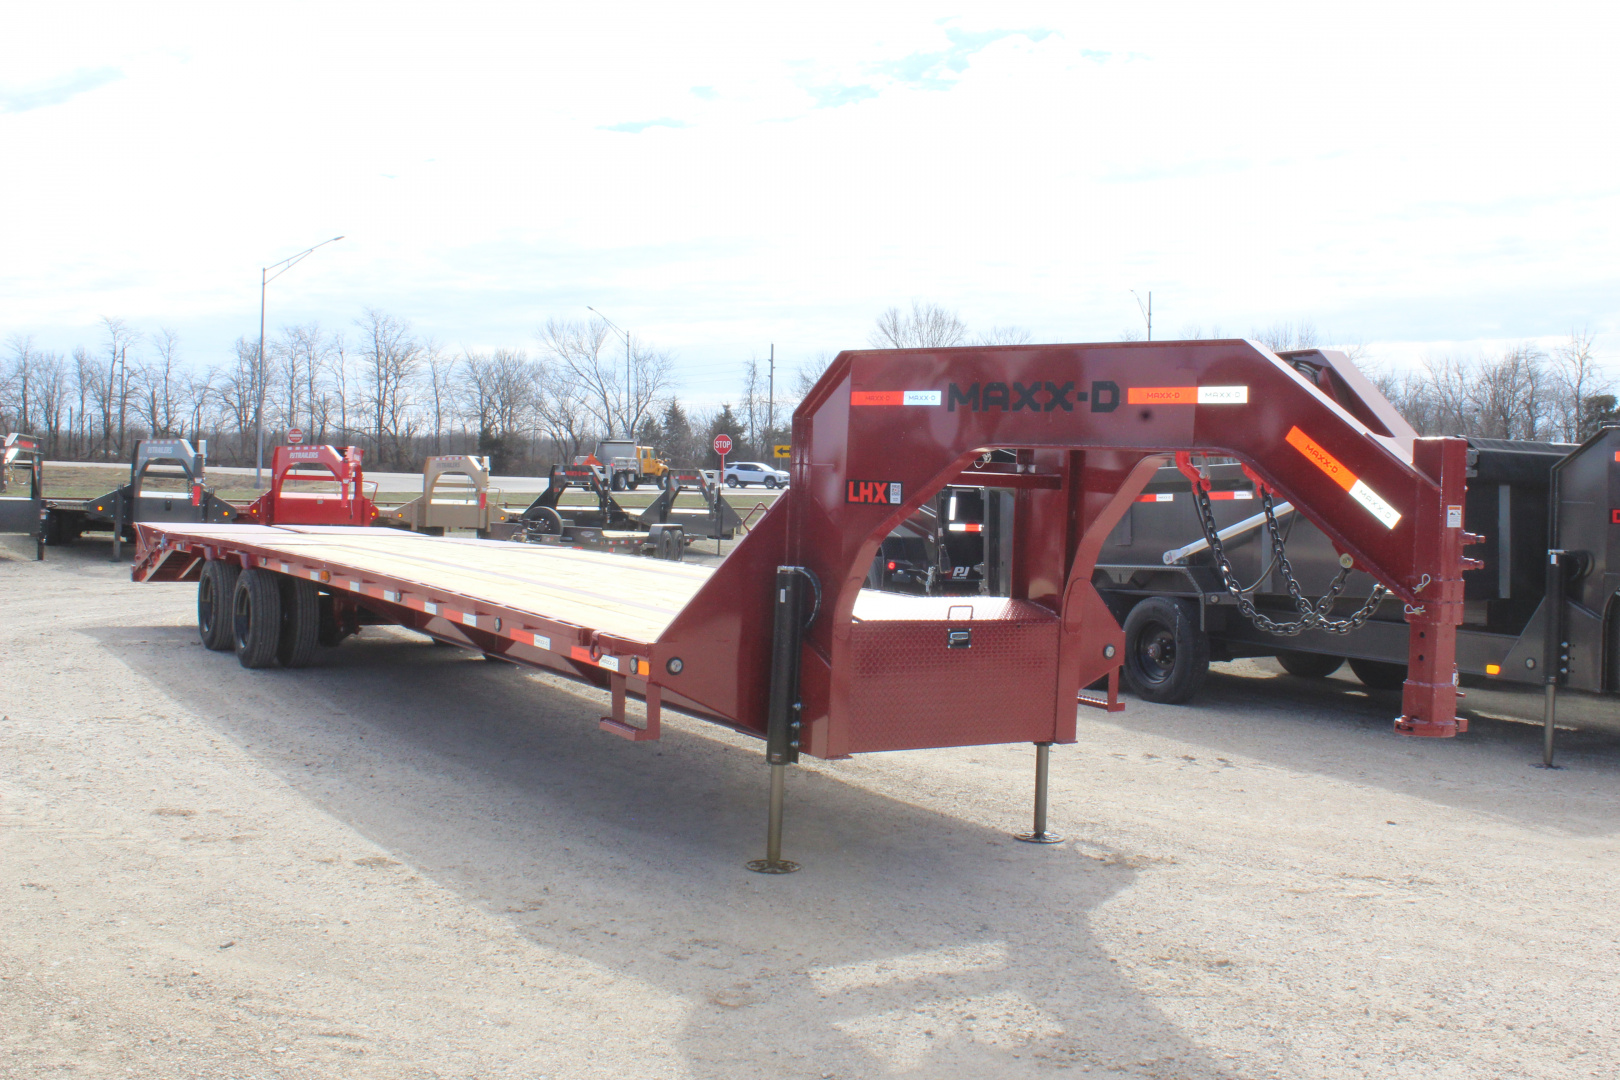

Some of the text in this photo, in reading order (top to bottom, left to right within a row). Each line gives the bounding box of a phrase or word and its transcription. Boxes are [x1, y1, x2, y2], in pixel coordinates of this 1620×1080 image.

[948, 381, 1120, 413] MAXX-D
[715, 440, 731, 449] STOP
[1305, 444, 1339, 474] MAXX-D
[848, 480, 888, 504] LHX
[1358, 489, 1392, 519] MAXX-D
[952, 566, 970, 577] PJ
